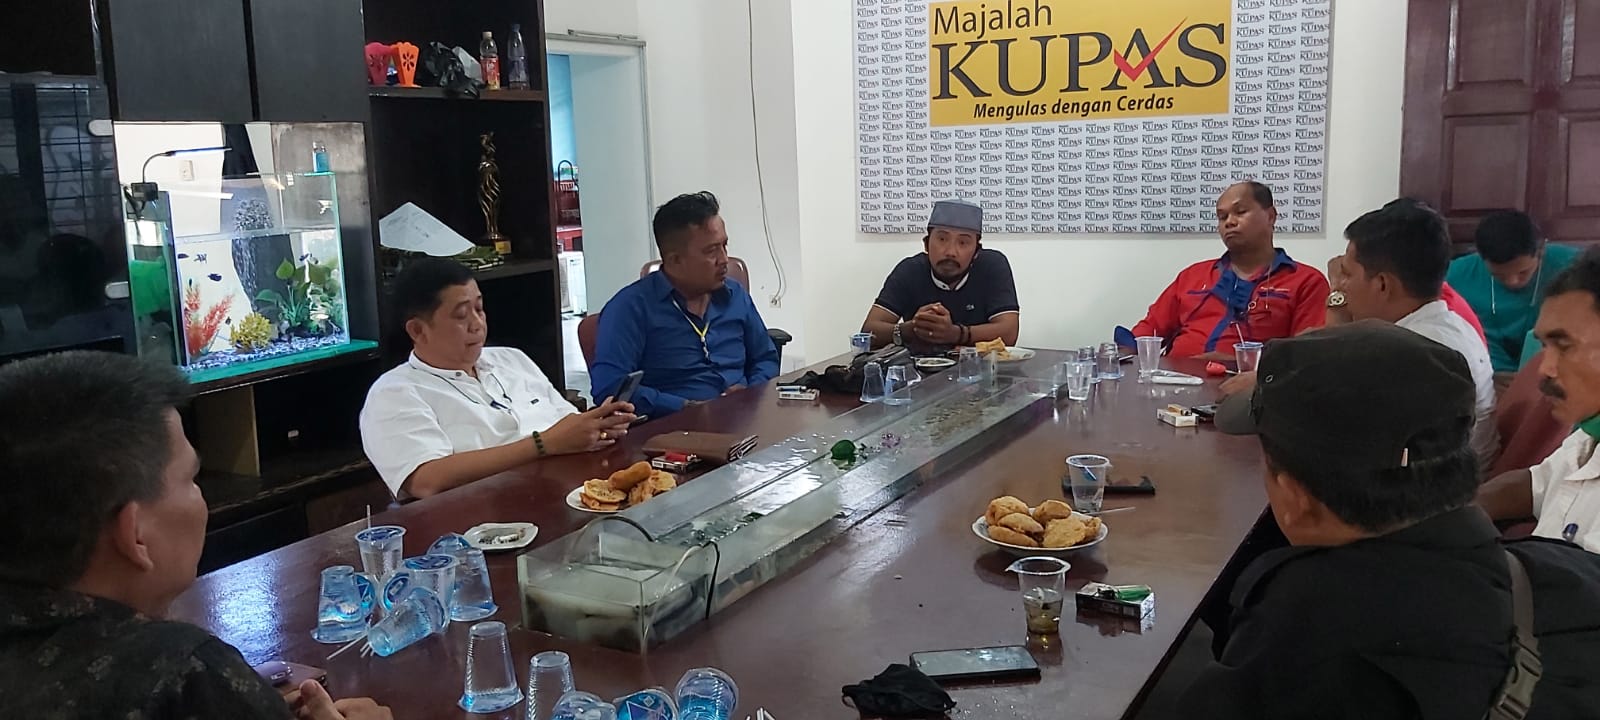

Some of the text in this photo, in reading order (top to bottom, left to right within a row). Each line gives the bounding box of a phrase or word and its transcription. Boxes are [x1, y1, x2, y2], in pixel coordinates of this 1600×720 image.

[934, 0, 1052, 39] Majalah
[1237, 14, 1264, 23] KUPAS
[1269, 12, 1297, 21] KUPAS
[1237, 27, 1264, 36] KUPAS
[1269, 25, 1297, 34] KUPAS
[1236, 42, 1263, 51] KUPAS
[1268, 39, 1296, 48] KUPAS
[932, 23, 1227, 100] KUPAS
[1236, 55, 1262, 64] KUPAS
[1267, 53, 1295, 62] KUPAS
[1235, 69, 1262, 78] KUPAS
[1267, 67, 1294, 76] KUPAS
[1234, 83, 1261, 92] KUPAS
[1266, 81, 1294, 90] KUPAS
[1234, 95, 1261, 104] KUPAS
[1265, 93, 1293, 102] KUPAS
[974, 94, 1175, 121] Mengulas dengan Cerdas
[1233, 106, 1260, 115] KUPAS
[1265, 104, 1293, 113] KUPAS
[930, 116, 1324, 140] KUPAS KUPAS KUPAS KUPAS KUPAS KUPAS KUPAS KUPAS KUPAS KUPAS KUPAS KUPAS KUPAS KUPAS
[860, 130, 1324, 155] KUPAS KUPAS KUPAS KUPAS KUPAS KUPAS KUPAS KUPAS KUPAS KUPAS KUPAS KUPAS KUPAS KUPAS KUPAS KUPAS KUPAS
[931, 144, 1323, 164] KUPAS KUPAS KUPAS KUPAS KUPAS KUPAS KUPAS KUPAS KUPAS KUPAS KUPAS KUPAS KUPAS KUPAS
[931, 157, 1322, 176] KUPAS KUPAS KUPAS KUPAS KUPAS KUPAS KUPAS KUPAS KUPAS KUPAS KUPAS KUPAS KUPAS KUPAS
[861, 171, 1322, 189] KUPAS KUPAS KUPAS KUPAS KUPAS KUPAS KUPAS KUPAS KUPAS KUPAS KUPAS KUPAS KUPAS KUPAS KUPAS KUPAS KUPAS
[931, 184, 1321, 199] KUPAS KUPAS KUPAS KUPAS KUPAS KUPAS KUPAS KUPAS KUPAS KUPAS KUPAS
[980, 198, 1321, 210] KUPAS KUPAS KUPAS KUPAS KUPAS KUPAS KUPAS KUPAS KUPAS
[861, 211, 1320, 223] KUPAS KUPAS KUPAS KUPAS KUPAS KUPAS KUPAS KUPAS KUPAS KUPAS KUPAS
[1006, 225, 1320, 234] KUPAS KUPAS KUPAS KUPAS KUPAS KUPAS KUPAS KUPAS
